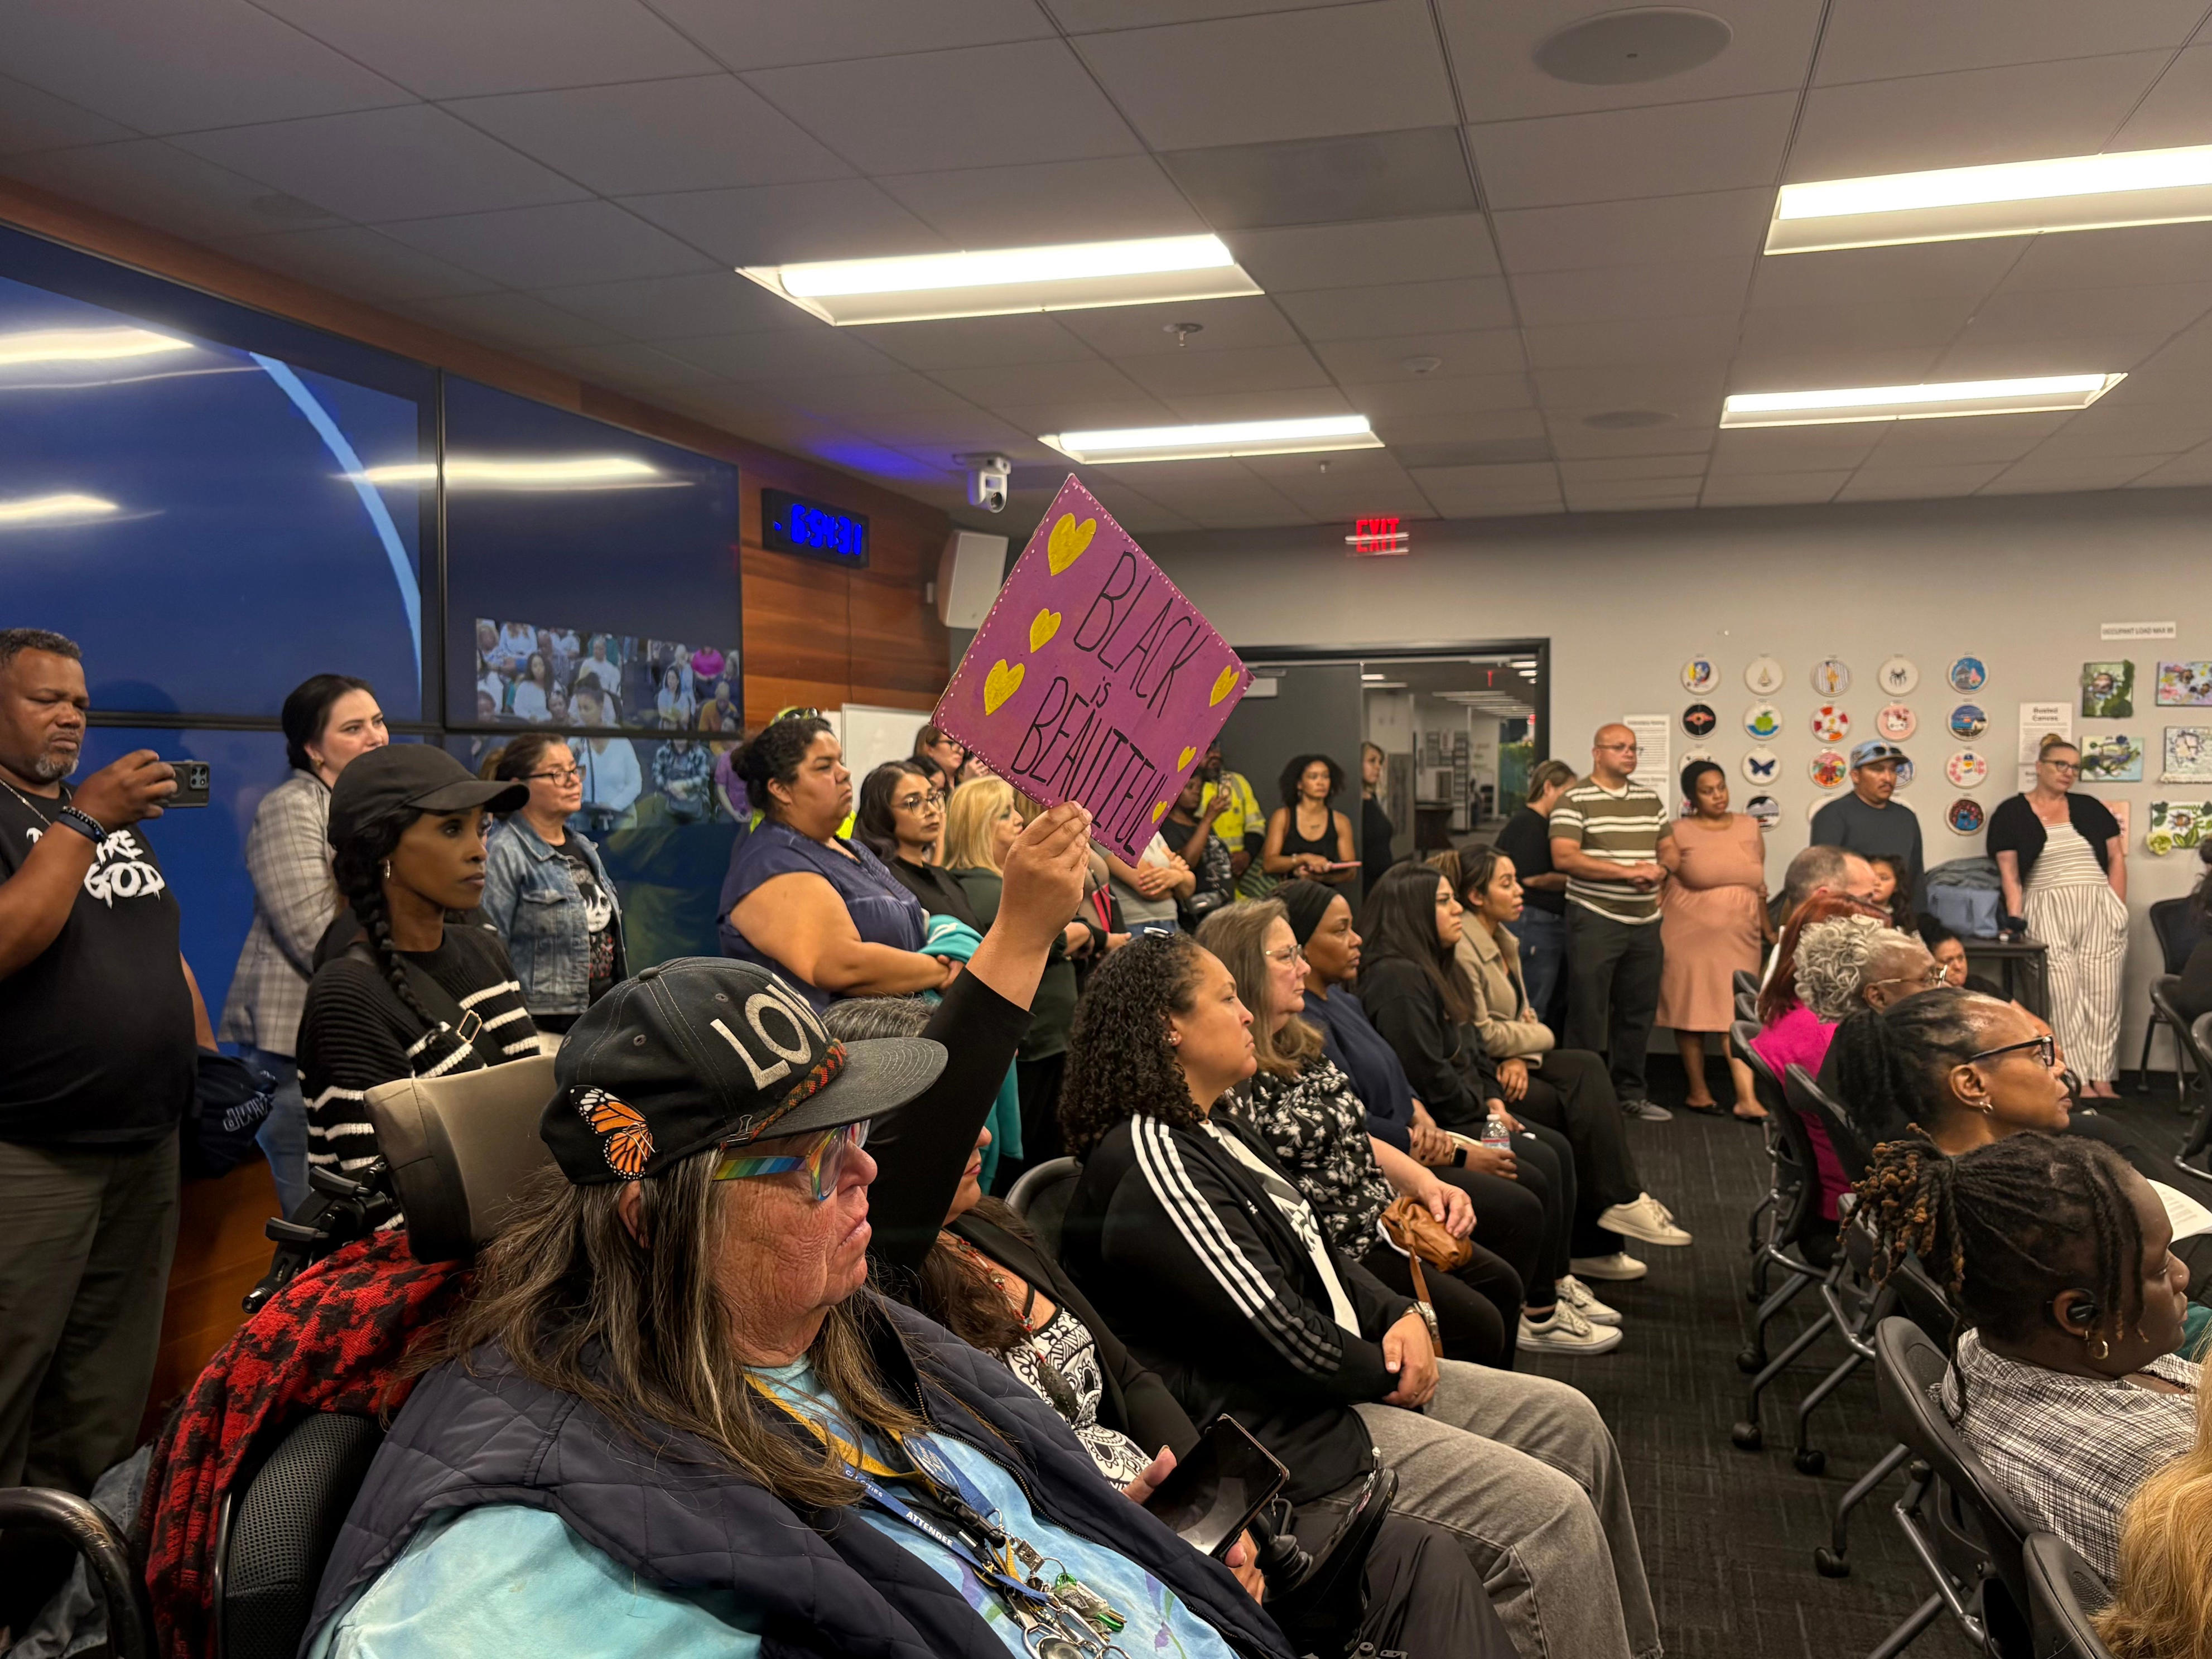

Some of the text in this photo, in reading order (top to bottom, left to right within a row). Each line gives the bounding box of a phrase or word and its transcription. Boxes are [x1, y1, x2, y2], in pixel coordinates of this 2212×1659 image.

[1356, 518, 1399, 552] EXIT
[1073, 550, 1209, 719] BLACK
[1090, 676, 1111, 708] is
[1010, 676, 1169, 856] BEAUTIFUL
[84, 861, 165, 910] GOD
[905, 1511, 955, 1547] ATTENDEE
